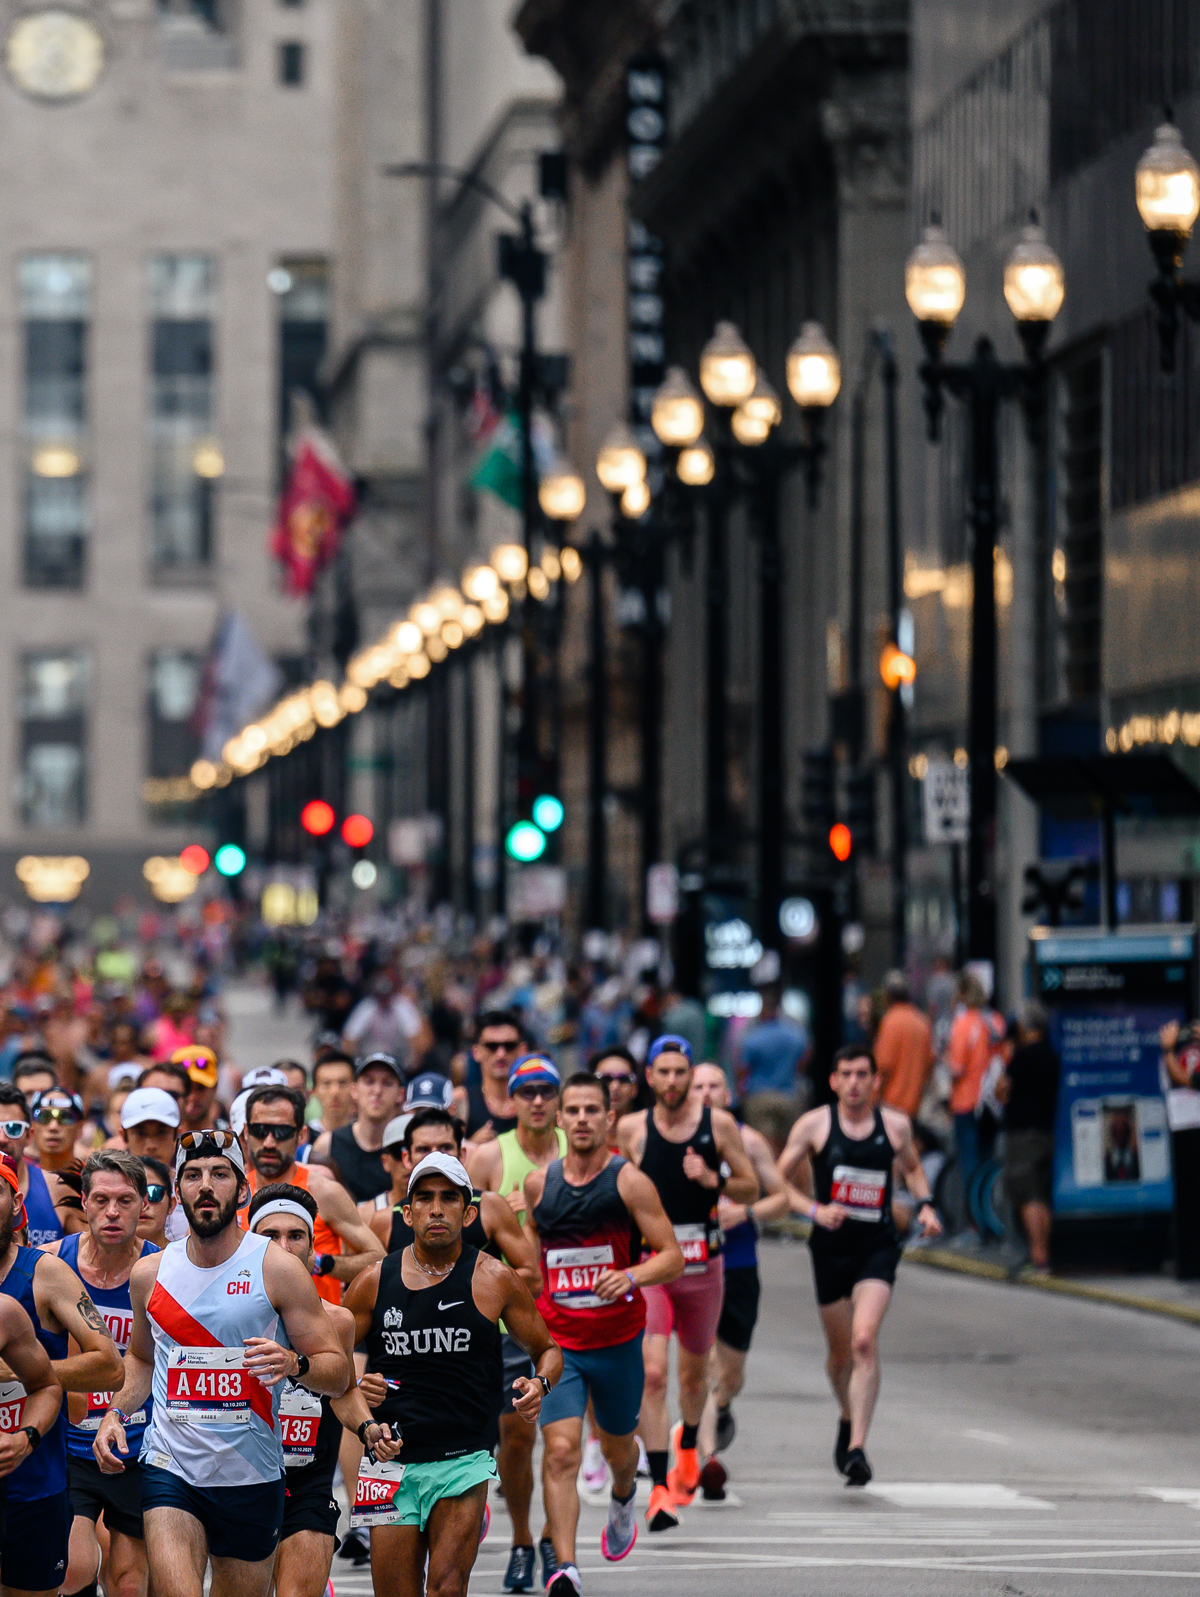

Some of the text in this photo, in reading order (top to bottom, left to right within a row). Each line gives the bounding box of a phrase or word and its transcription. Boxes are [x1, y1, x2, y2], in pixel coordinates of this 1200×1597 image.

[226, 1281, 250, 1295] CHI
[557, 1269, 570, 1290] A
[176, 1372, 242, 1397] A 4183
[356, 1479, 392, 1502] 9166
